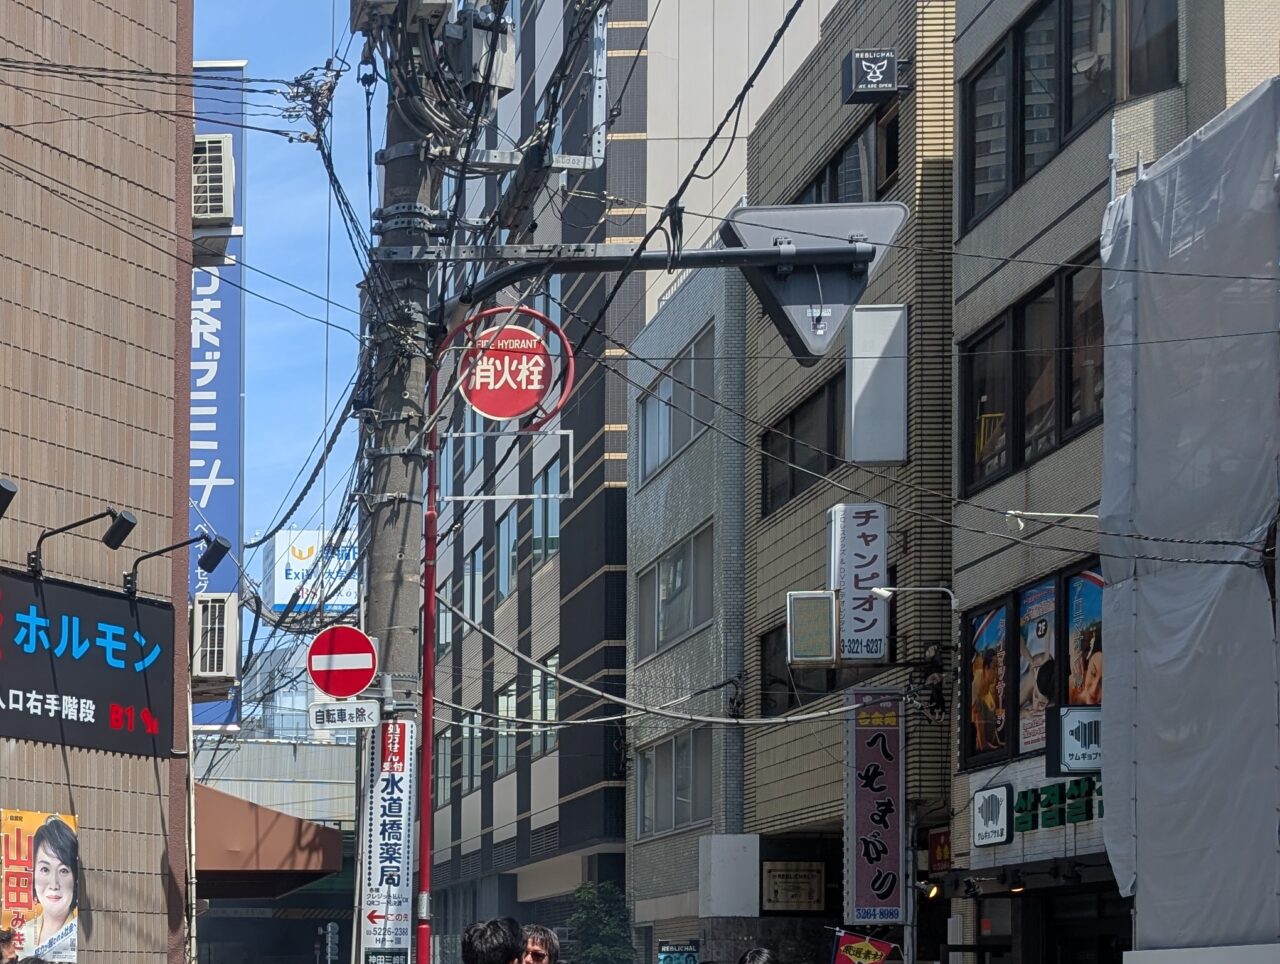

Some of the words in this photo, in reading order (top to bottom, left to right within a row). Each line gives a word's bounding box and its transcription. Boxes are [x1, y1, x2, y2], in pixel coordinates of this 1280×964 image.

[497, 339, 538, 349] HYDRANT
[468, 355, 546, 390] 消火栓
[852, 509, 880, 633] チャンピオン
[13, 604, 162, 673] ホルモン
[108, 703, 135, 733] B1
[315, 708, 374, 725] 自転車を除く
[387, 724, 400, 762] 処方せん
[382, 762, 403, 772] 受付
[378, 773, 404, 887] 水道橋薬局
[857, 732, 897, 900] へそまがり
[3, 827, 34, 951] 山田みき
